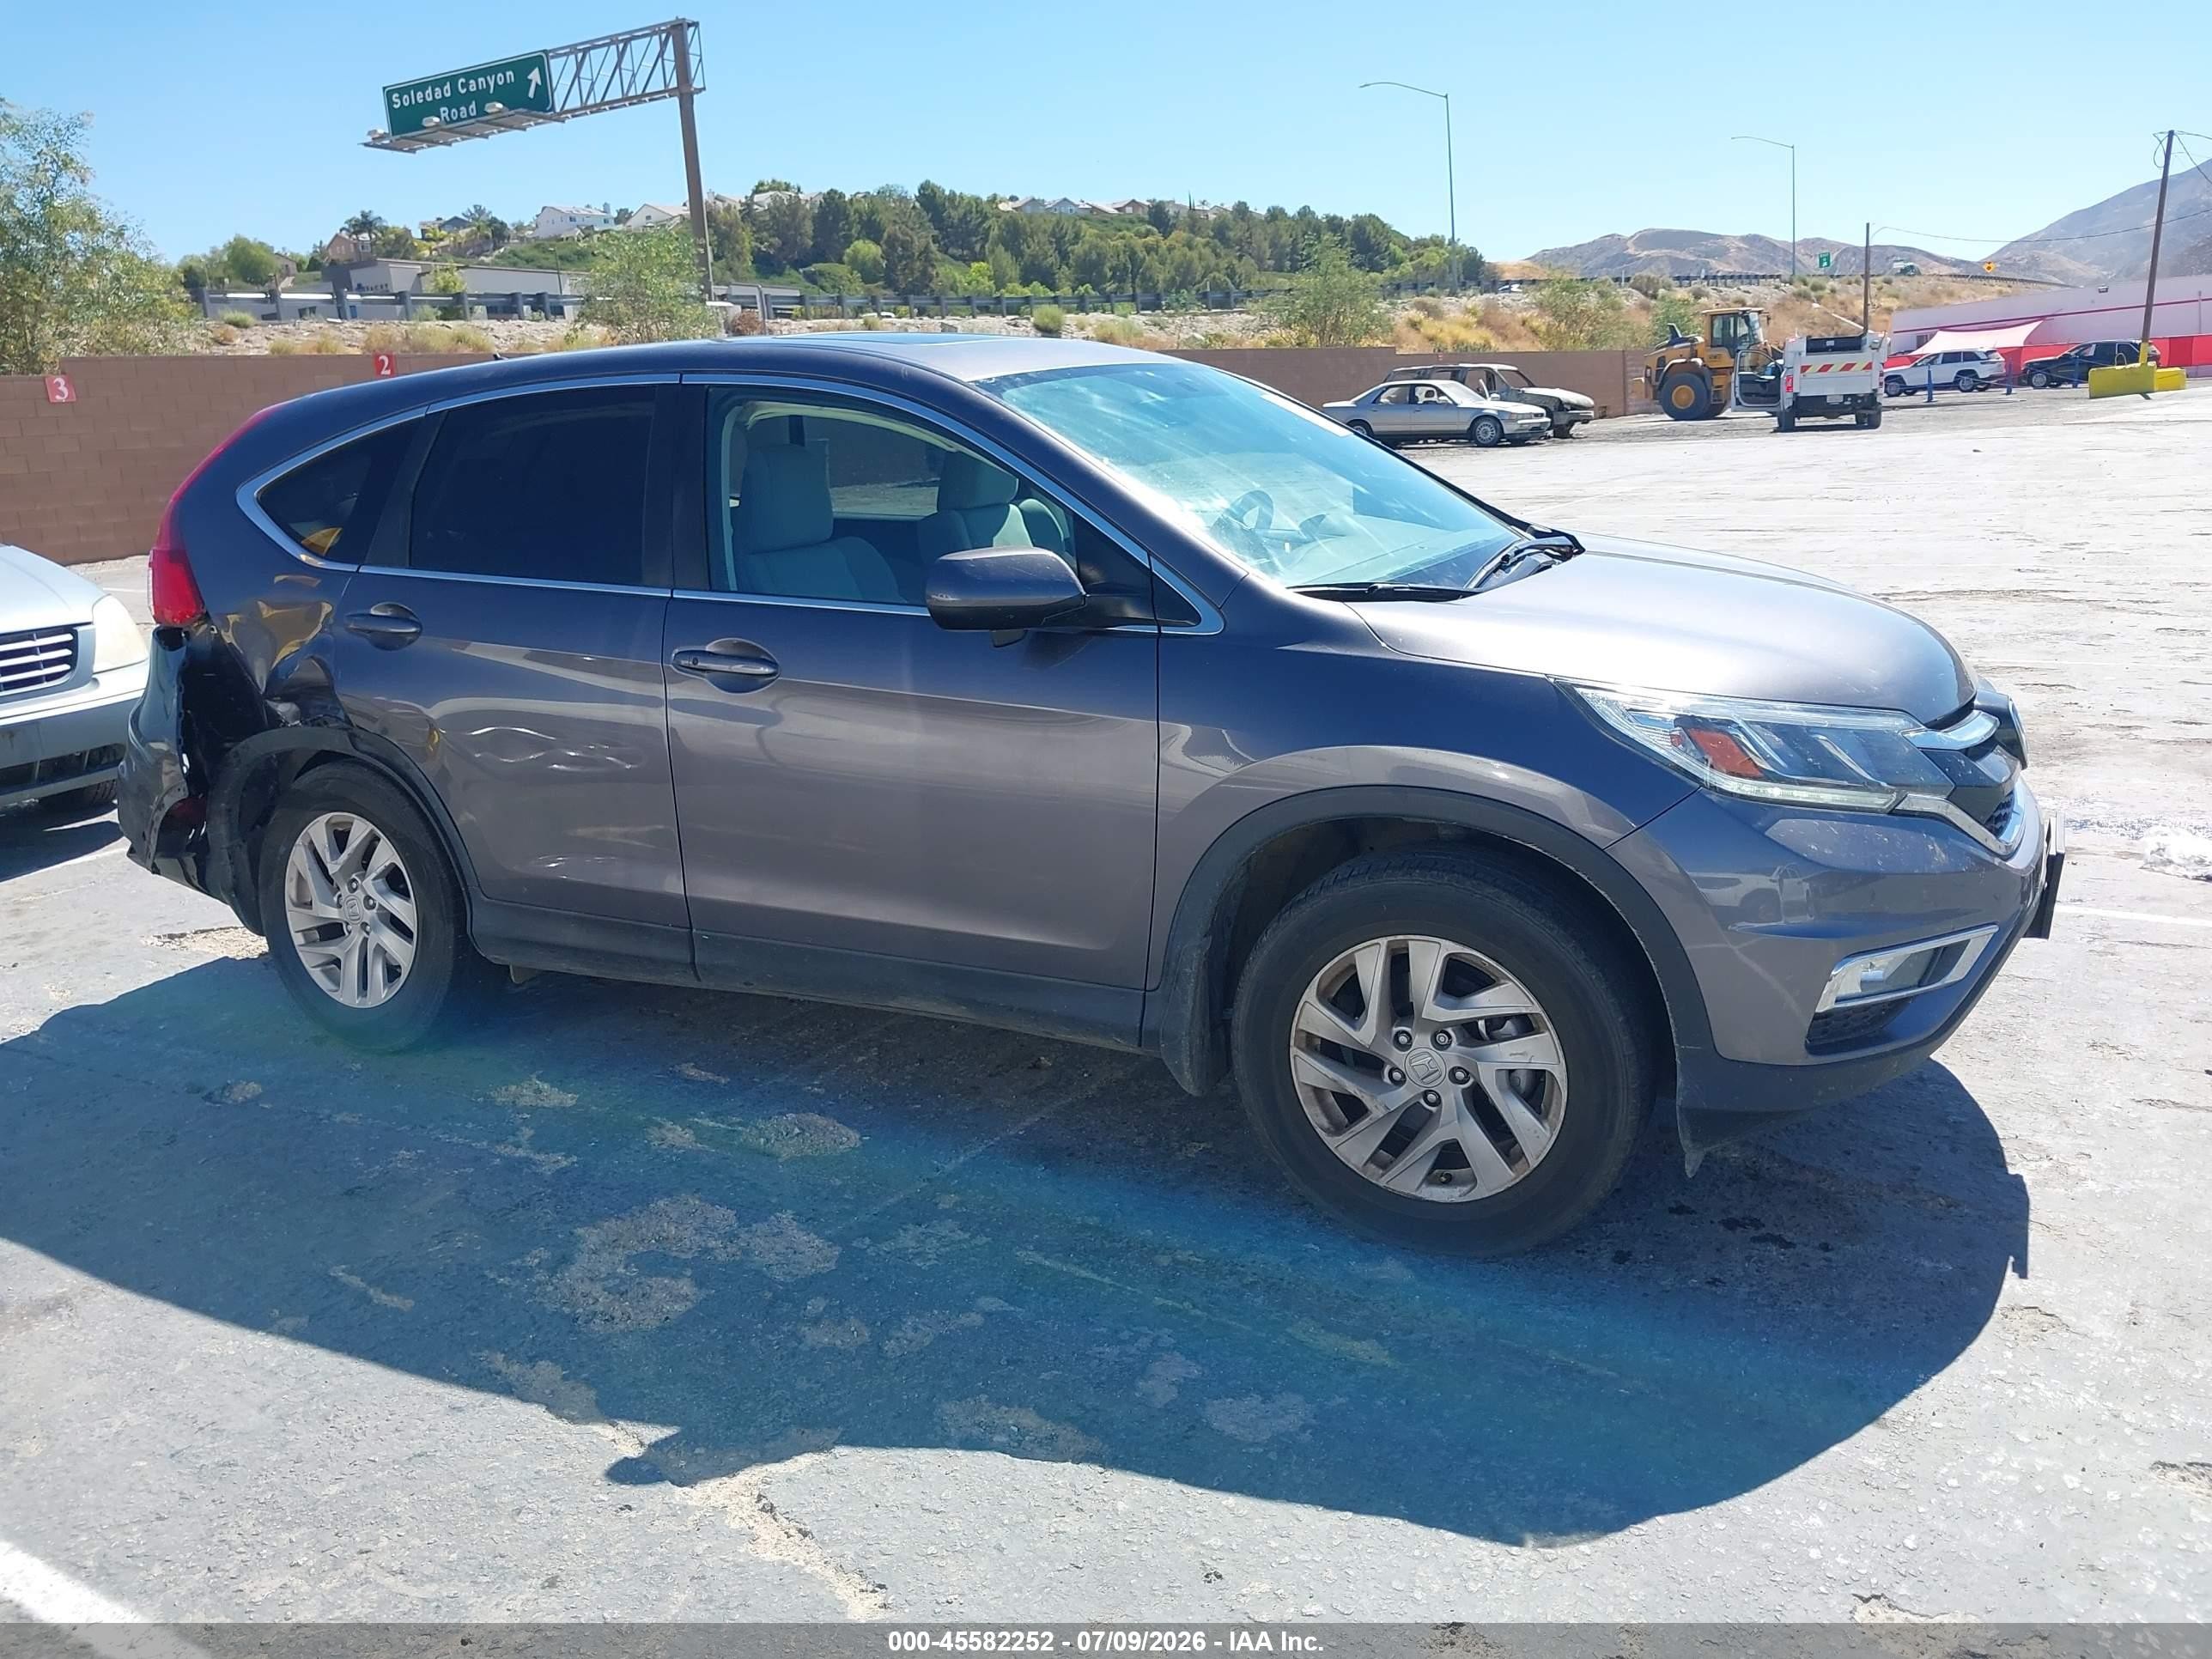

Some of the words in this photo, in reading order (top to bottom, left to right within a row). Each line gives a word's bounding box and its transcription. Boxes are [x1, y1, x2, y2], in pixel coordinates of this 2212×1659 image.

[392, 82, 452, 109] Soledad
[458, 70, 514, 94] Canyon
[440, 100, 477, 122] Road
[379, 355, 391, 374] 2
[53, 378, 68, 399] 3
